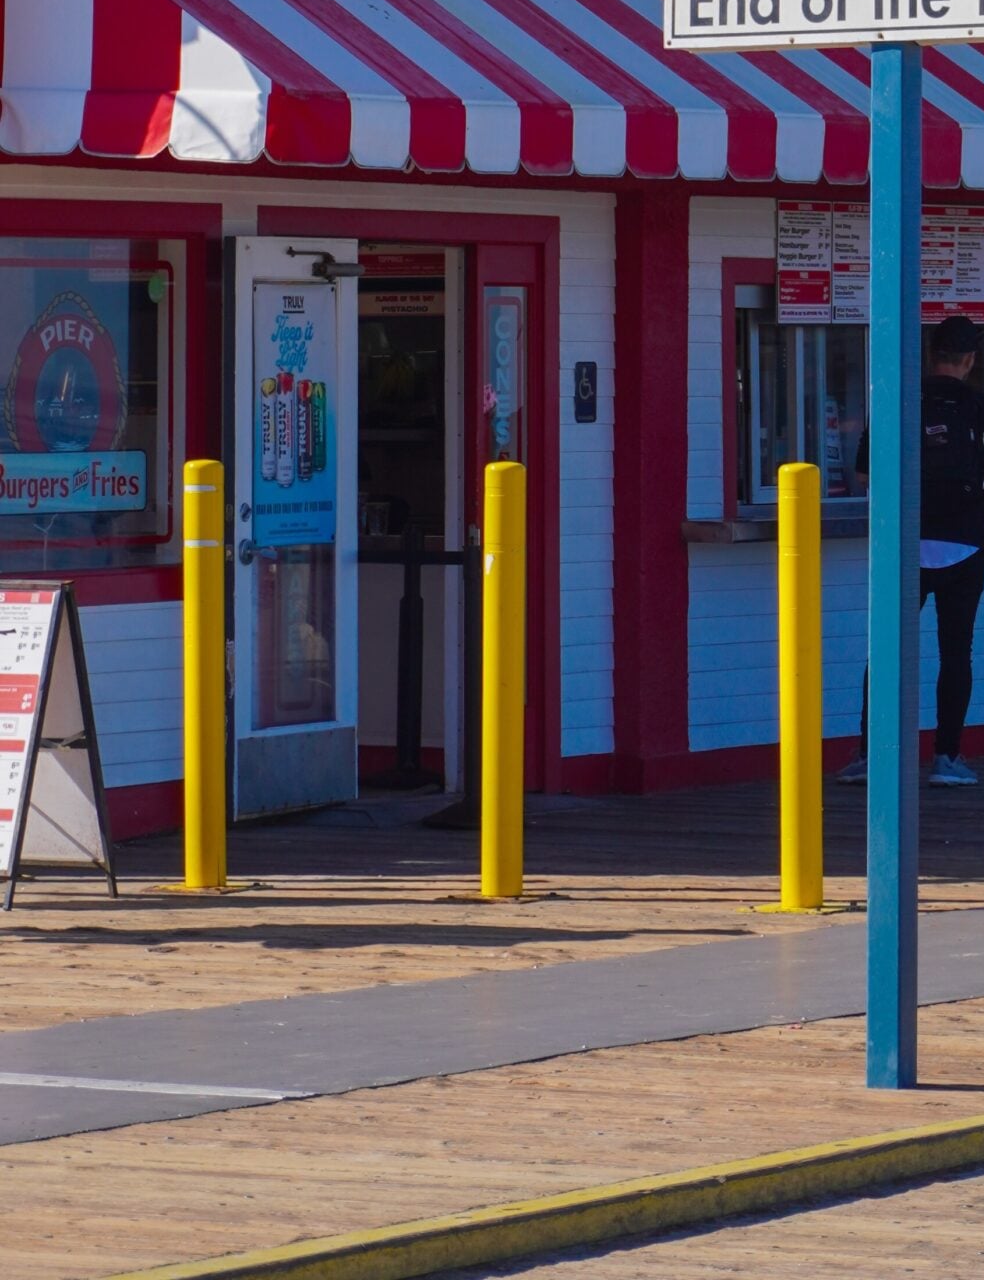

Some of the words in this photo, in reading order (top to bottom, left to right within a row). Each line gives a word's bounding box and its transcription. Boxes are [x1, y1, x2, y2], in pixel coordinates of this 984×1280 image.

[282, 295, 305, 309] TRULY
[39, 319, 94, 352] PIER
[271, 315, 302, 342] Keep
[304, 321, 314, 341] it
[494, 316, 512, 446] CONES
[278, 401, 286, 459] TRULY
[298, 402, 307, 457] TRULY
[74, 472, 89, 489] AND
[91, 461, 140, 498] Fries
